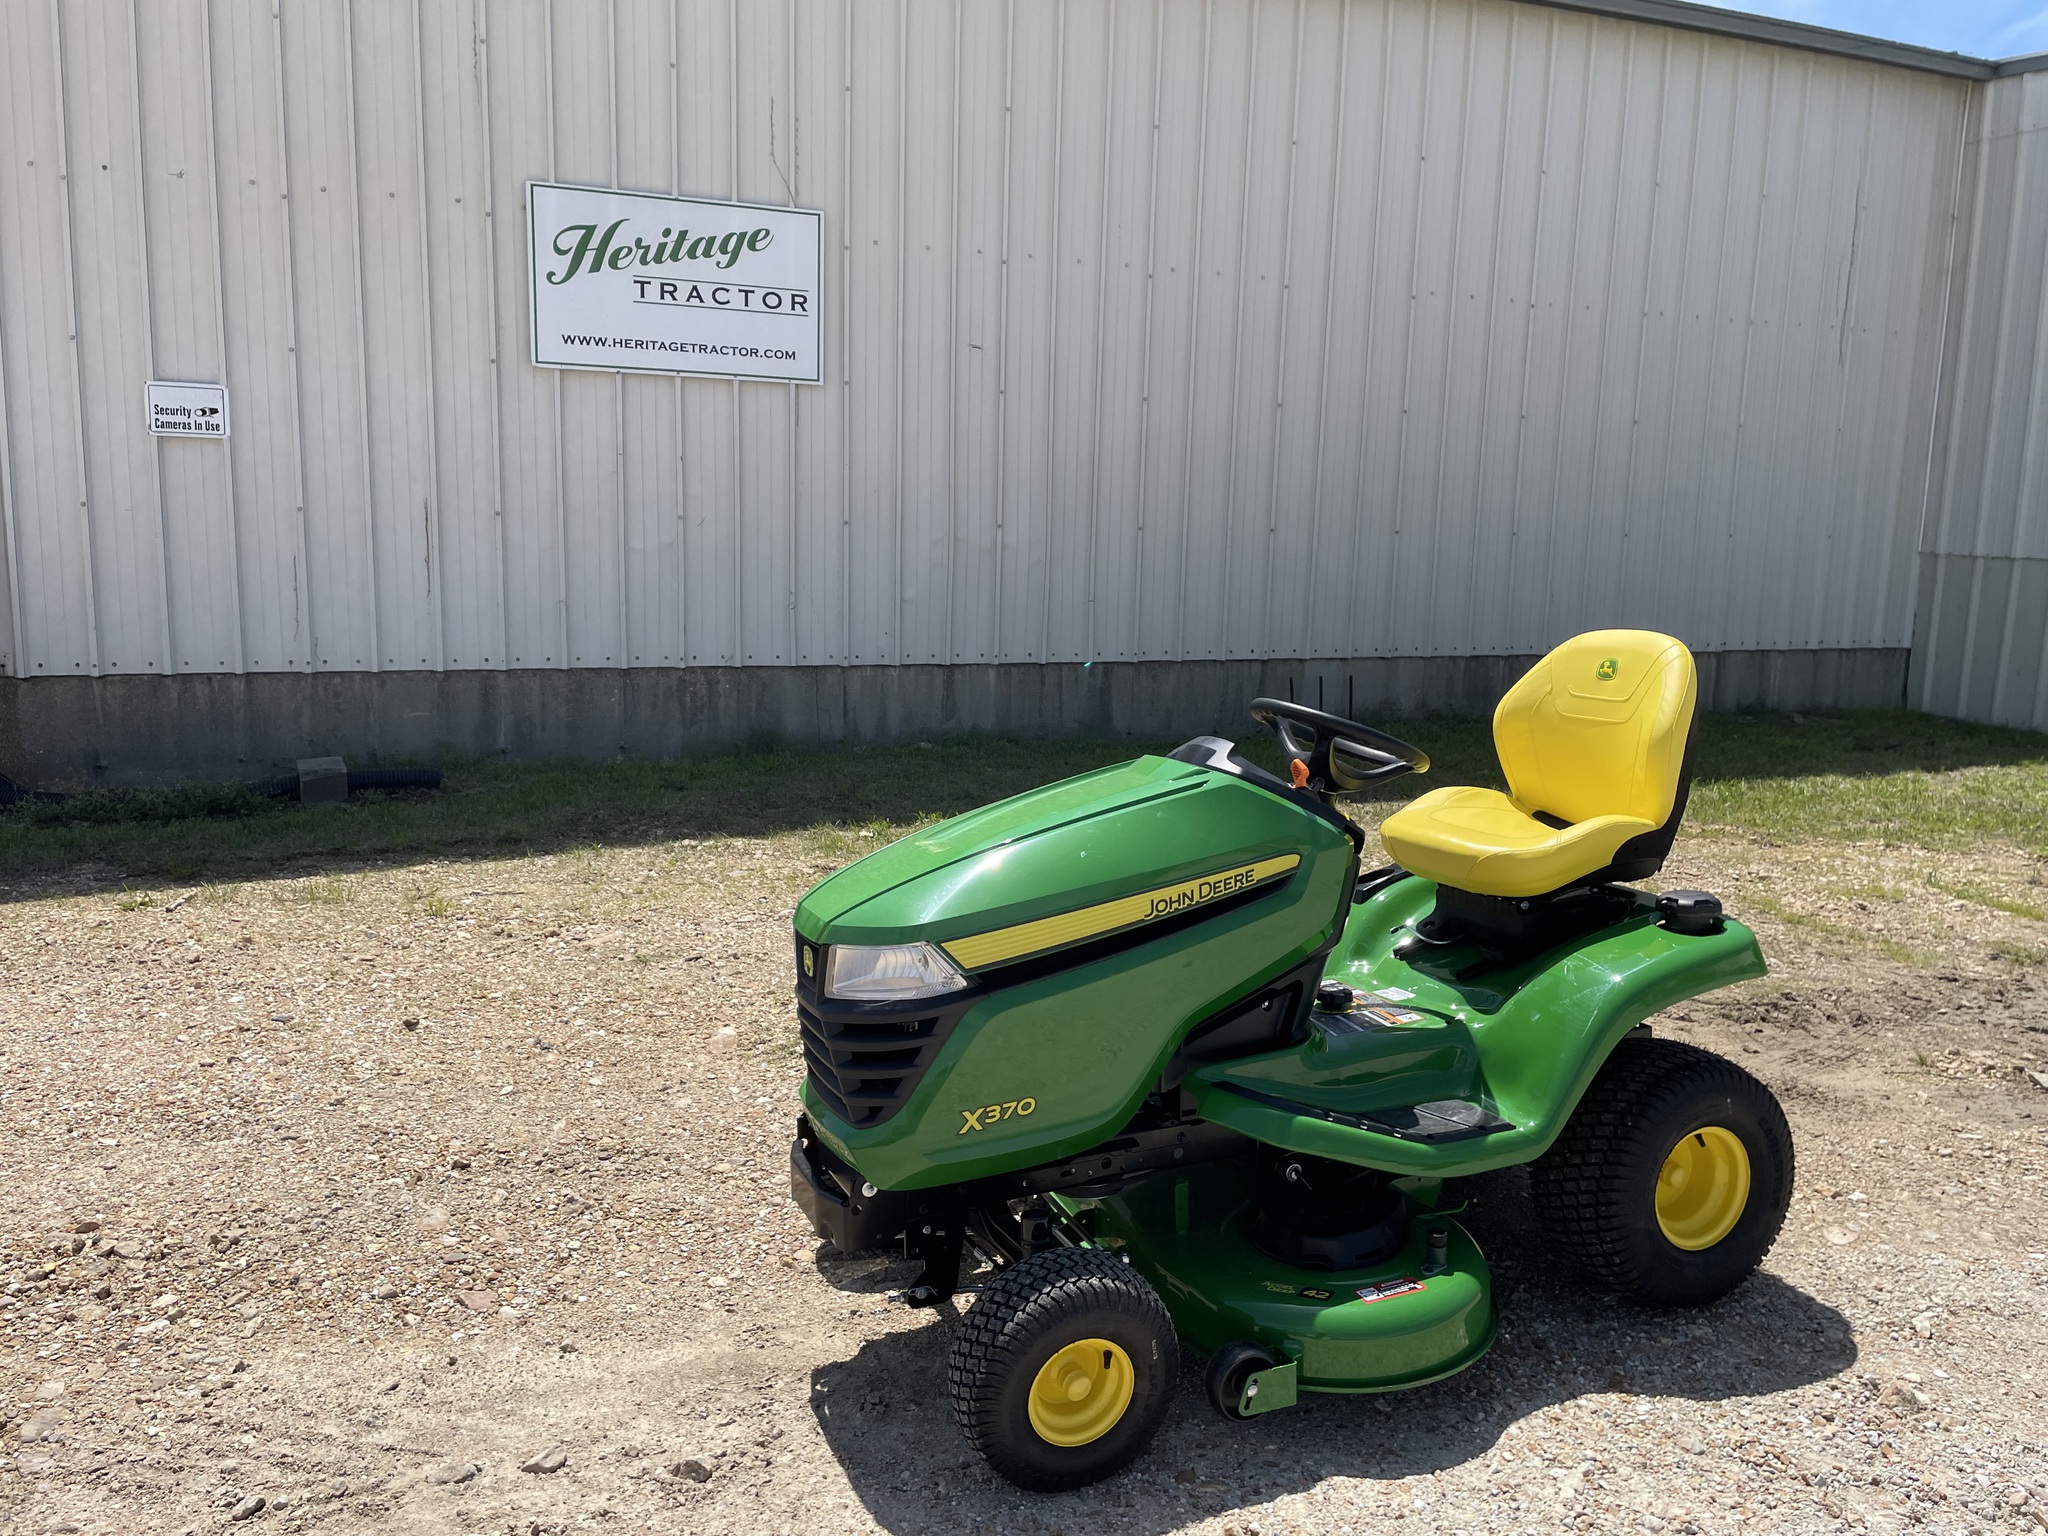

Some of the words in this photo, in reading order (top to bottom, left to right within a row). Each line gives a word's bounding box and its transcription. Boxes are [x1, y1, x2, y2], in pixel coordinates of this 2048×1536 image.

[546, 218, 775, 285] Heritage
[633, 279, 809, 312] TRACTOR
[561, 334, 796, 361] WWW.HERITAGETRACTOR.COM
[154, 404, 192, 419] Security
[154, 418, 192, 430] Cameras
[194, 419, 203, 431] In
[205, 420, 221, 432] Use
[1144, 889, 1195, 919] JOHN
[1199, 868, 1256, 901] DEERE
[957, 1096, 1037, 1136] X370
[1303, 1289, 1330, 1299] 42
